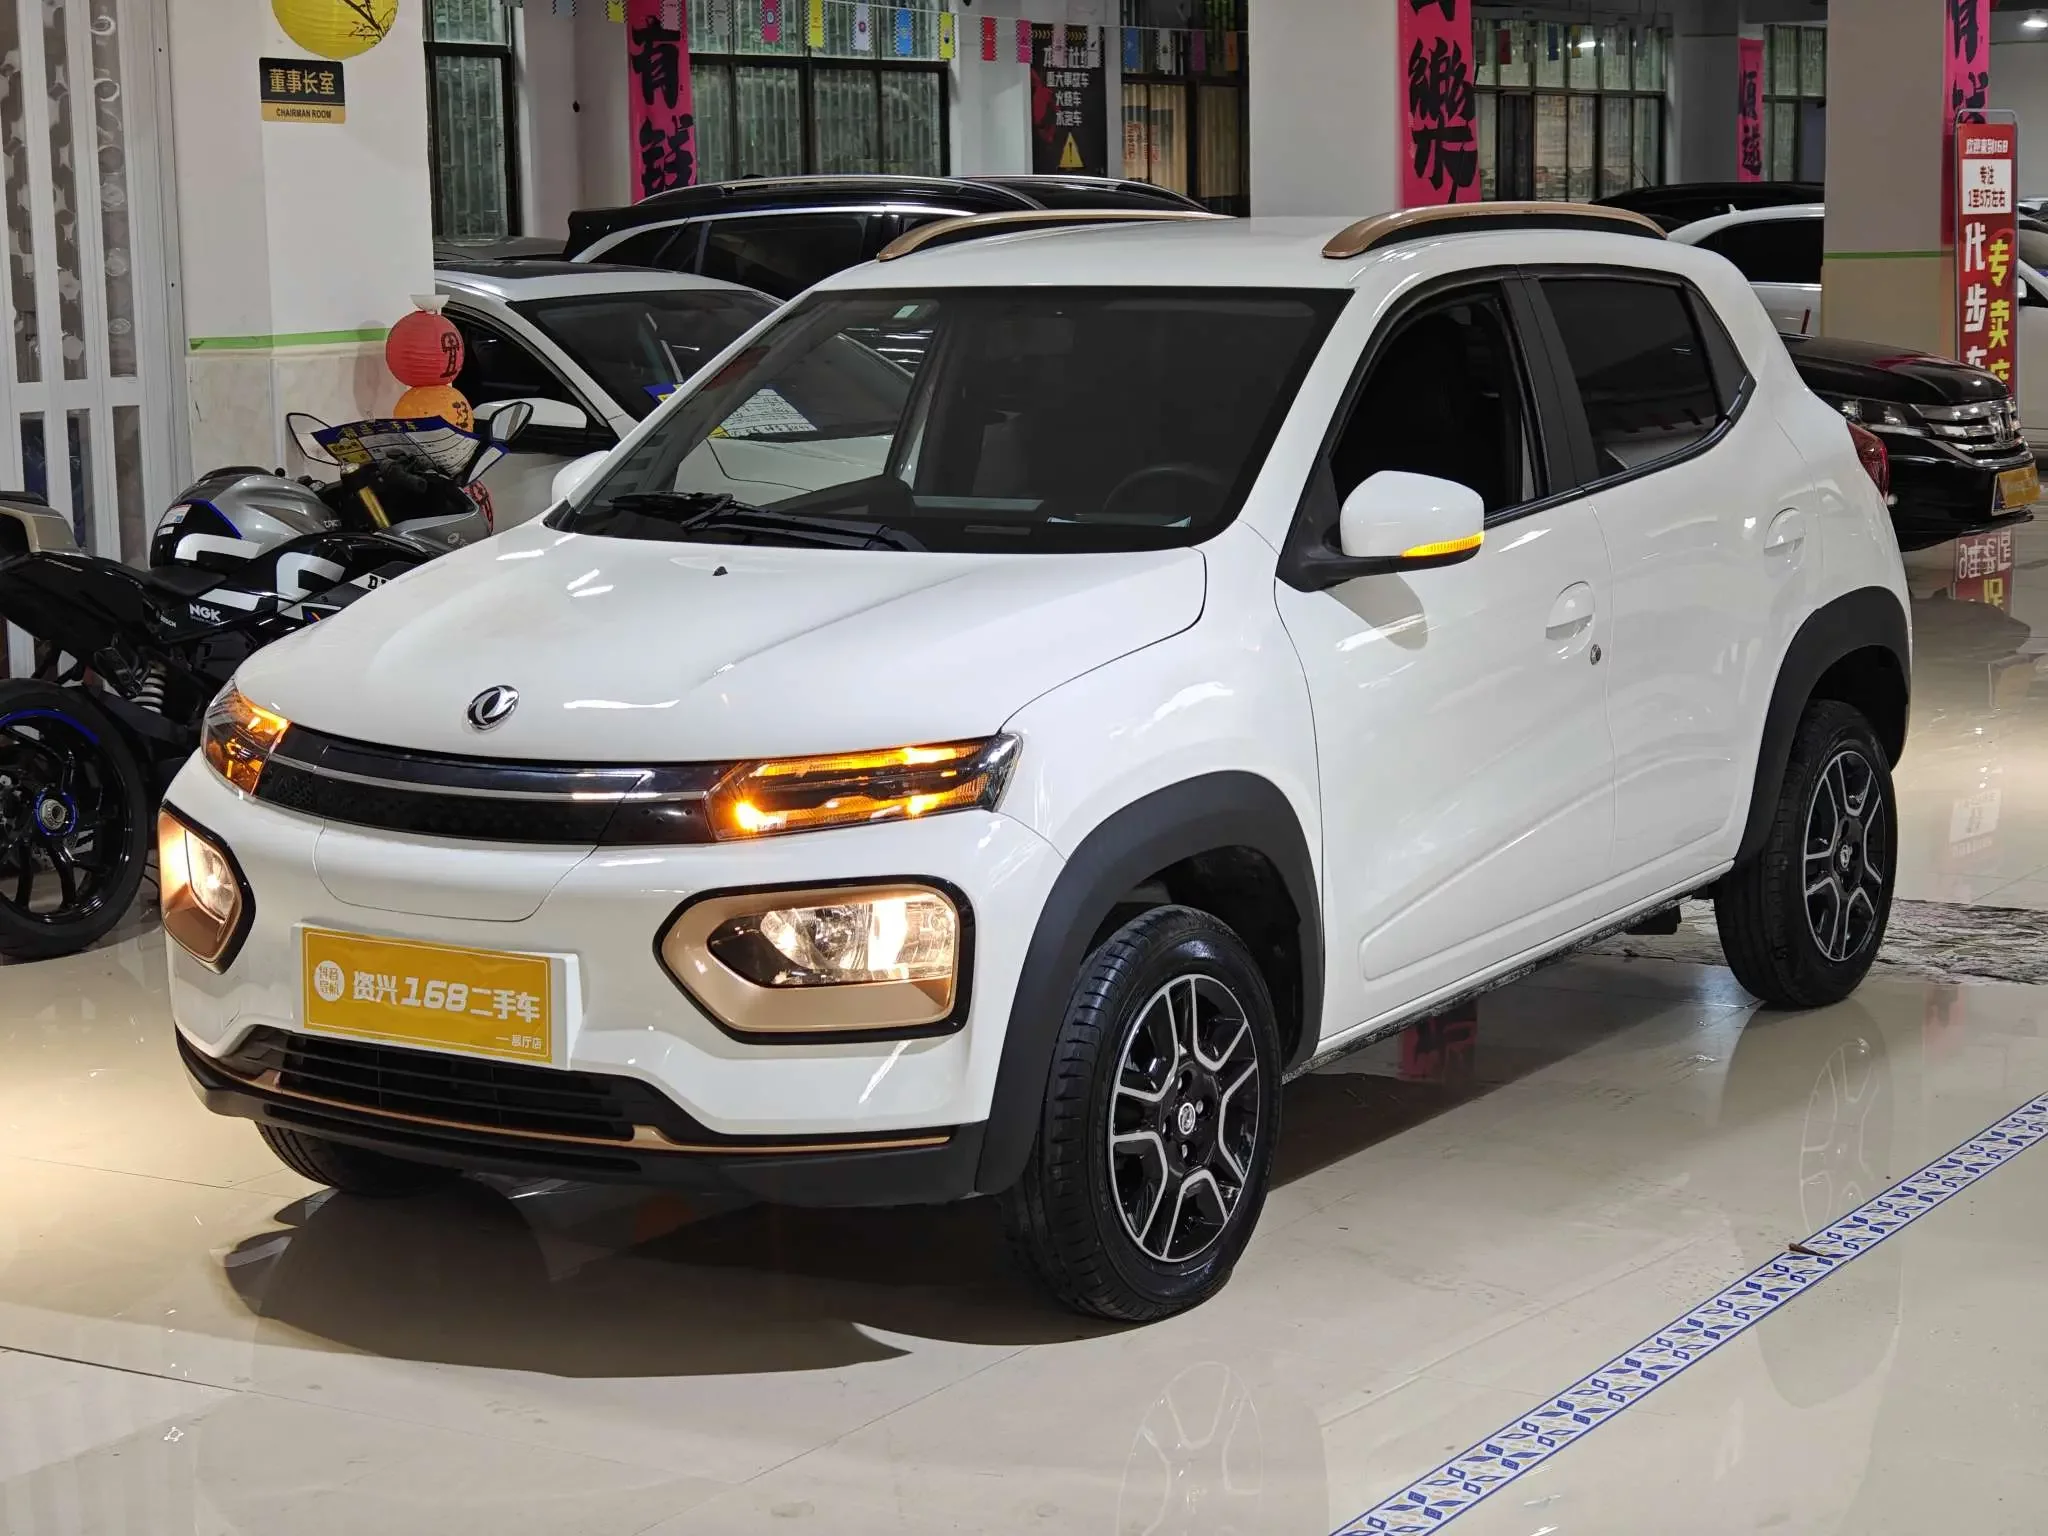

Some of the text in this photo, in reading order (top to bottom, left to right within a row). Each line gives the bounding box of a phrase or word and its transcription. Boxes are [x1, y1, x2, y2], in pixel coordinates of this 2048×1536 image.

[268, 67, 336, 95] 董事长室
[276, 108, 332, 119] CHAIRMAN ROOM
[1980, 165, 1995, 185] 专注
[189, 603, 221, 622] NGK
